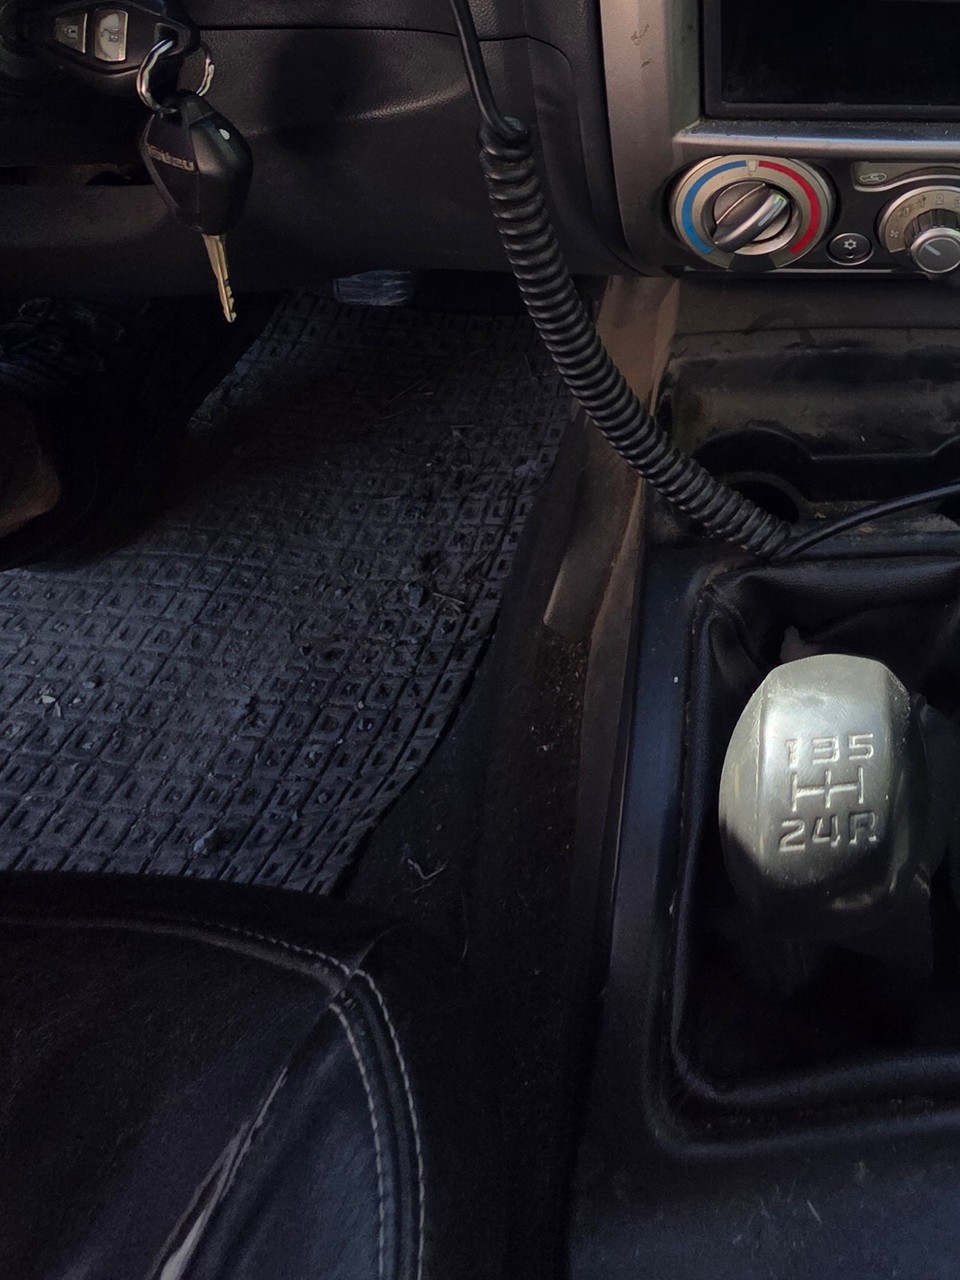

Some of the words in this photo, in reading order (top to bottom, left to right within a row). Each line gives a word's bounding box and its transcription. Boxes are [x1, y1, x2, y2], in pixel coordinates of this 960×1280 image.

[935, 194, 945, 204] 2
[785, 738, 799, 768] 1
[811, 736, 840, 765] 3
[848, 733, 874, 761] 5
[778, 819, 806, 853] 2
[811, 813, 841, 848] 4
[848, 810, 878, 845] R
